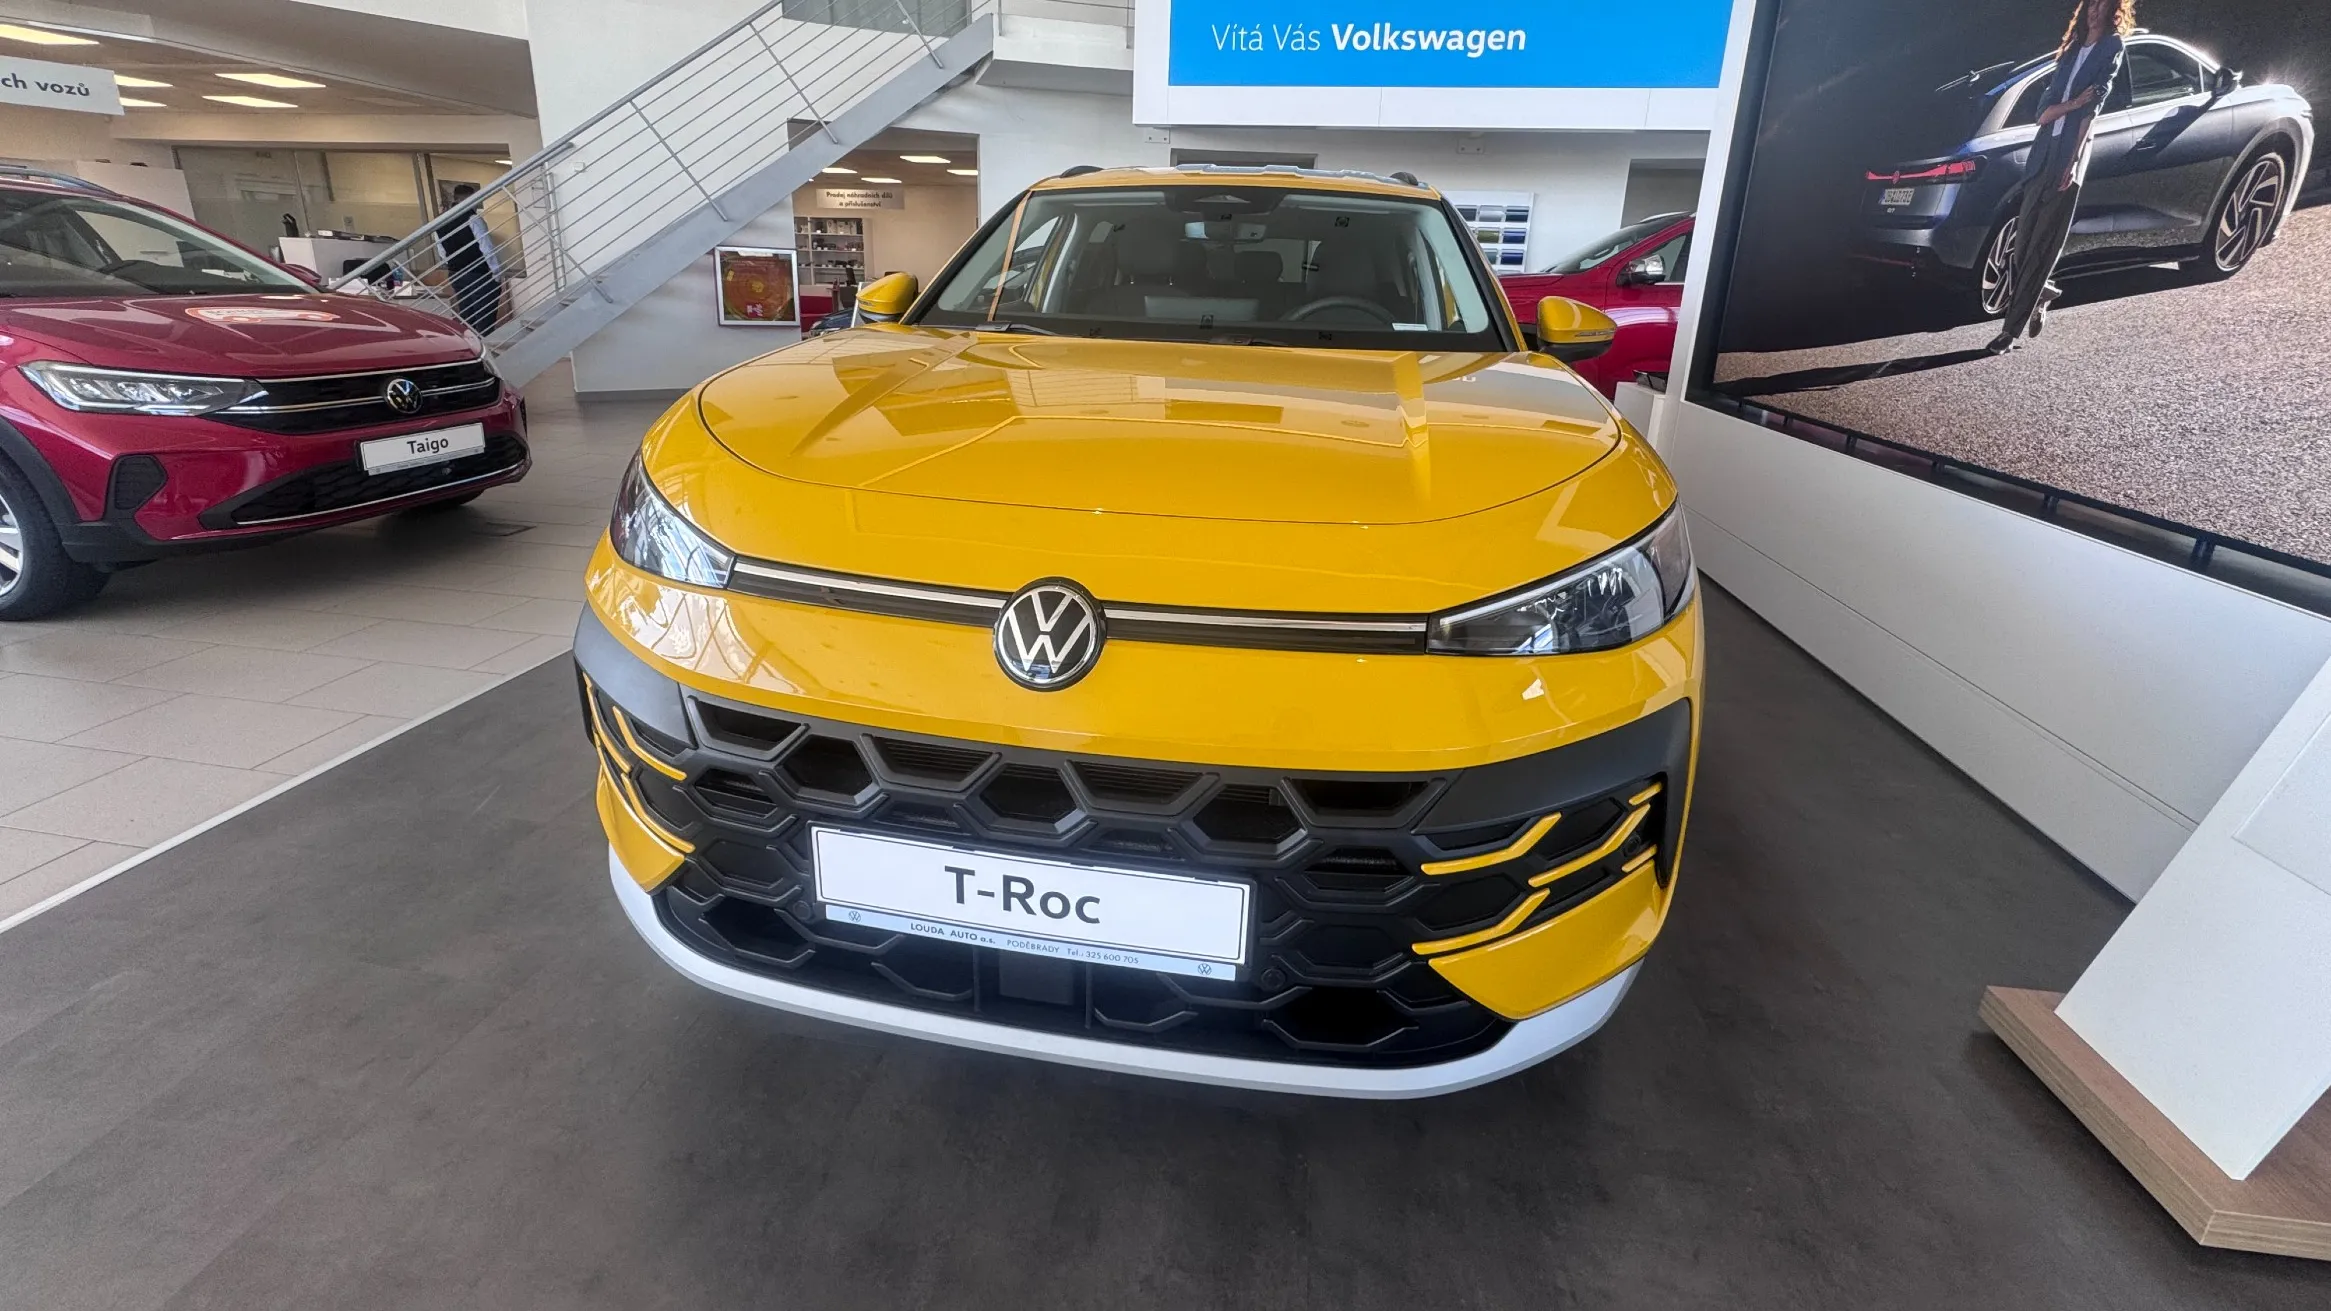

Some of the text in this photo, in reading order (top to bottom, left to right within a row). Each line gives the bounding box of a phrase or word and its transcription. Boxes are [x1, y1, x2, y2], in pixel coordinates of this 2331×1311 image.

[1211, 22, 1527, 58] Vítá Vás Volkswagen
[34, 81, 91, 97] vozů
[826, 191, 846, 199] Prodej
[407, 438, 449, 454] Taigo
[944, 865, 1101, 924] T-Roc
[910, 922, 945, 936] LOUDA
[950, 929, 978, 941] AUTO
[1006, 938, 1061, 954] PODĚBRADY
[1085, 951, 1102, 960] 325
[1103, 953, 1121, 962] 600
[1122, 954, 1140, 964] 705
